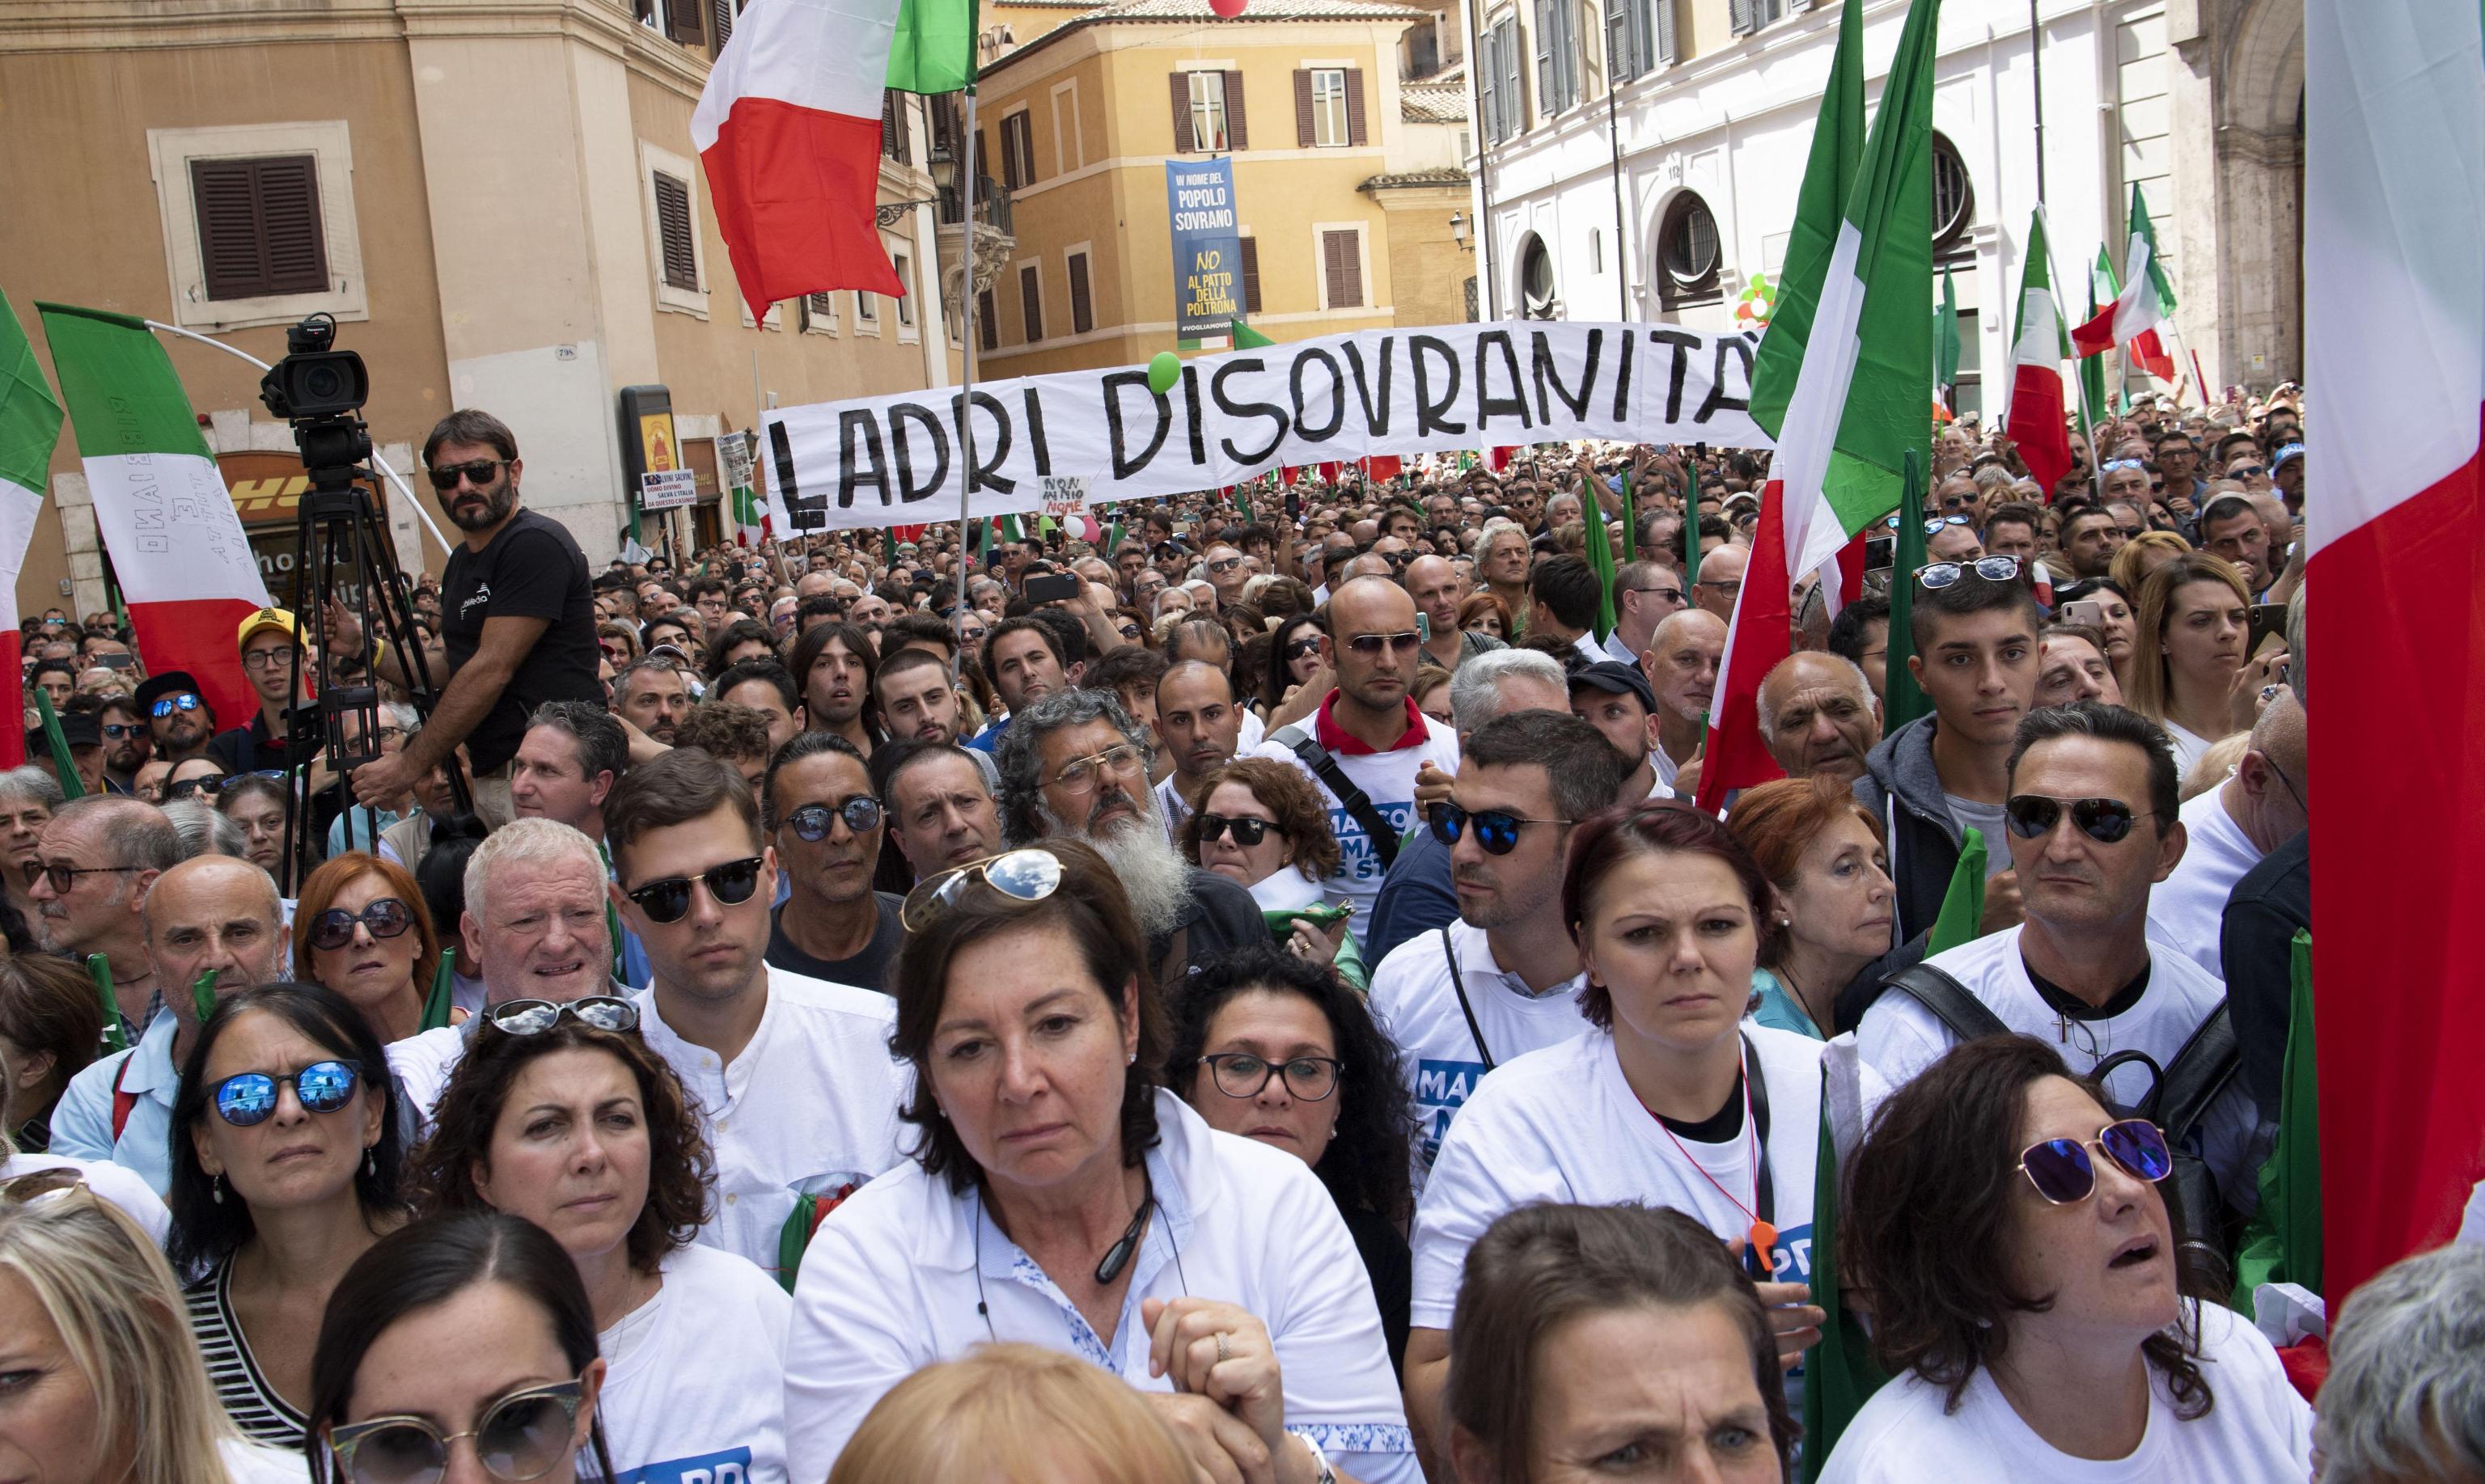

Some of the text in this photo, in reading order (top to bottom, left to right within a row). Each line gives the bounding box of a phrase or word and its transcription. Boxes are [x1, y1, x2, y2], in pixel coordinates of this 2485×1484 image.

[1186, 173, 1209, 186] NOME
[1209, 172, 1225, 184] DEL
[1178, 187, 1226, 209] POPOLO
[1175, 209, 1233, 231] SOVRANO
[1196, 250, 1221, 273] NO
[1187, 272, 1232, 290] AL PATTO
[1196, 286, 1226, 302] DELLA
[1187, 298, 1237, 317] POLTRONA
[1182, 320, 1243, 332] #VOGLIAMOVOT
[768, 387, 1053, 512] LADRI
[1044, 477, 1080, 490] NON
[655, 498, 675, 507] QUESTO
[1046, 500, 1083, 514] NOME
[1340, 838, 1380, 860] MA
